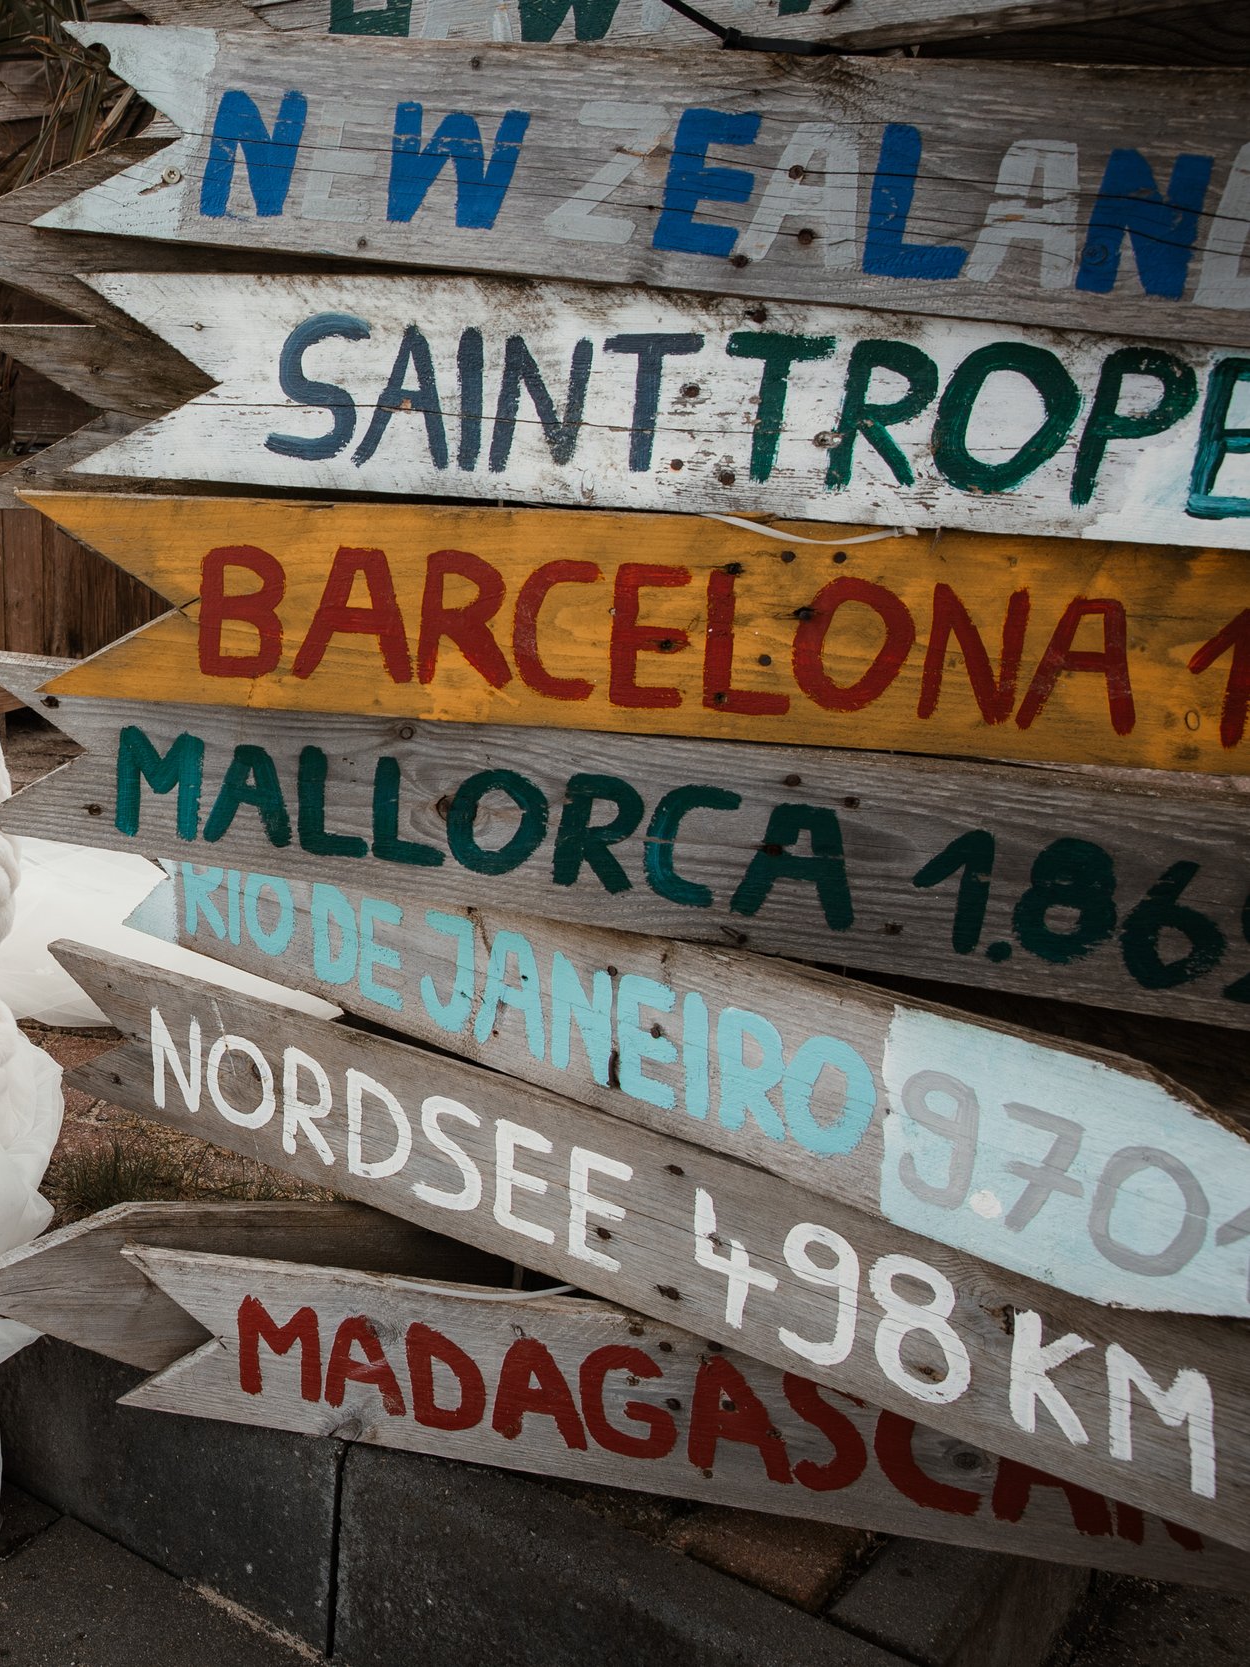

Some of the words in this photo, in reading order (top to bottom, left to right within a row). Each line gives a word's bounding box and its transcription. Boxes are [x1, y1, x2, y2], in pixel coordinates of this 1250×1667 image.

[200, 89, 530, 230] NEW
[264, 311, 705, 472] SAINT
[198, 544, 1137, 736] BARCELONA
[114, 725, 854, 932] MALLORCA
[912, 829, 1250, 1004] 1.86
[181, 861, 297, 957] RIO
[311, 883, 405, 1012] DE
[420, 909, 877, 1158] JANEIRO
[150, 1006, 634, 1273] NORDSEE
[694, 1187, 971, 1405] 498
[1009, 1307, 1217, 1499] KM
[237, 1294, 1215, 1554] MADAGASCA
